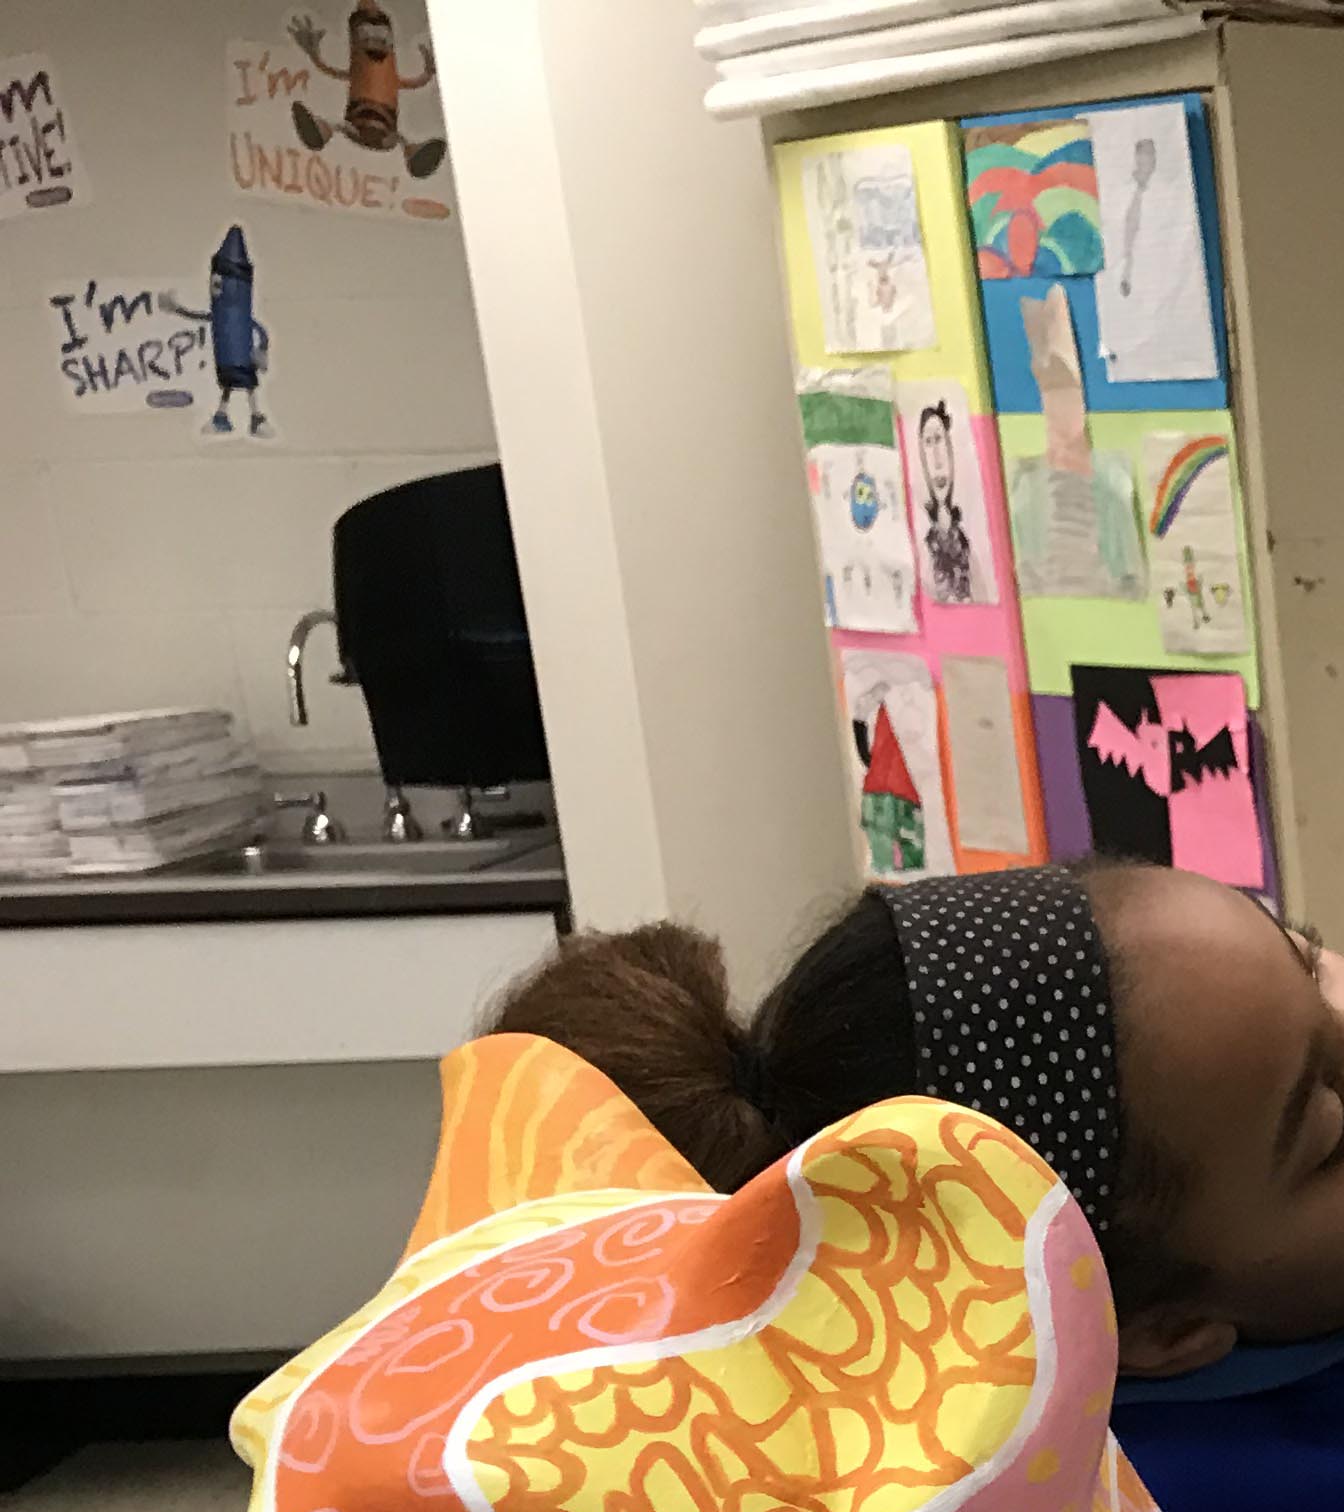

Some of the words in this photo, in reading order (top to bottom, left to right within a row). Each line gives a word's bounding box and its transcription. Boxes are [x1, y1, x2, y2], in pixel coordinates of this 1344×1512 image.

[232, 50, 310, 107] I'm
[229, 131, 400, 210] UNIQUE!
[49, 279, 154, 354] I'm
[60, 325, 207, 397] SHARP!
